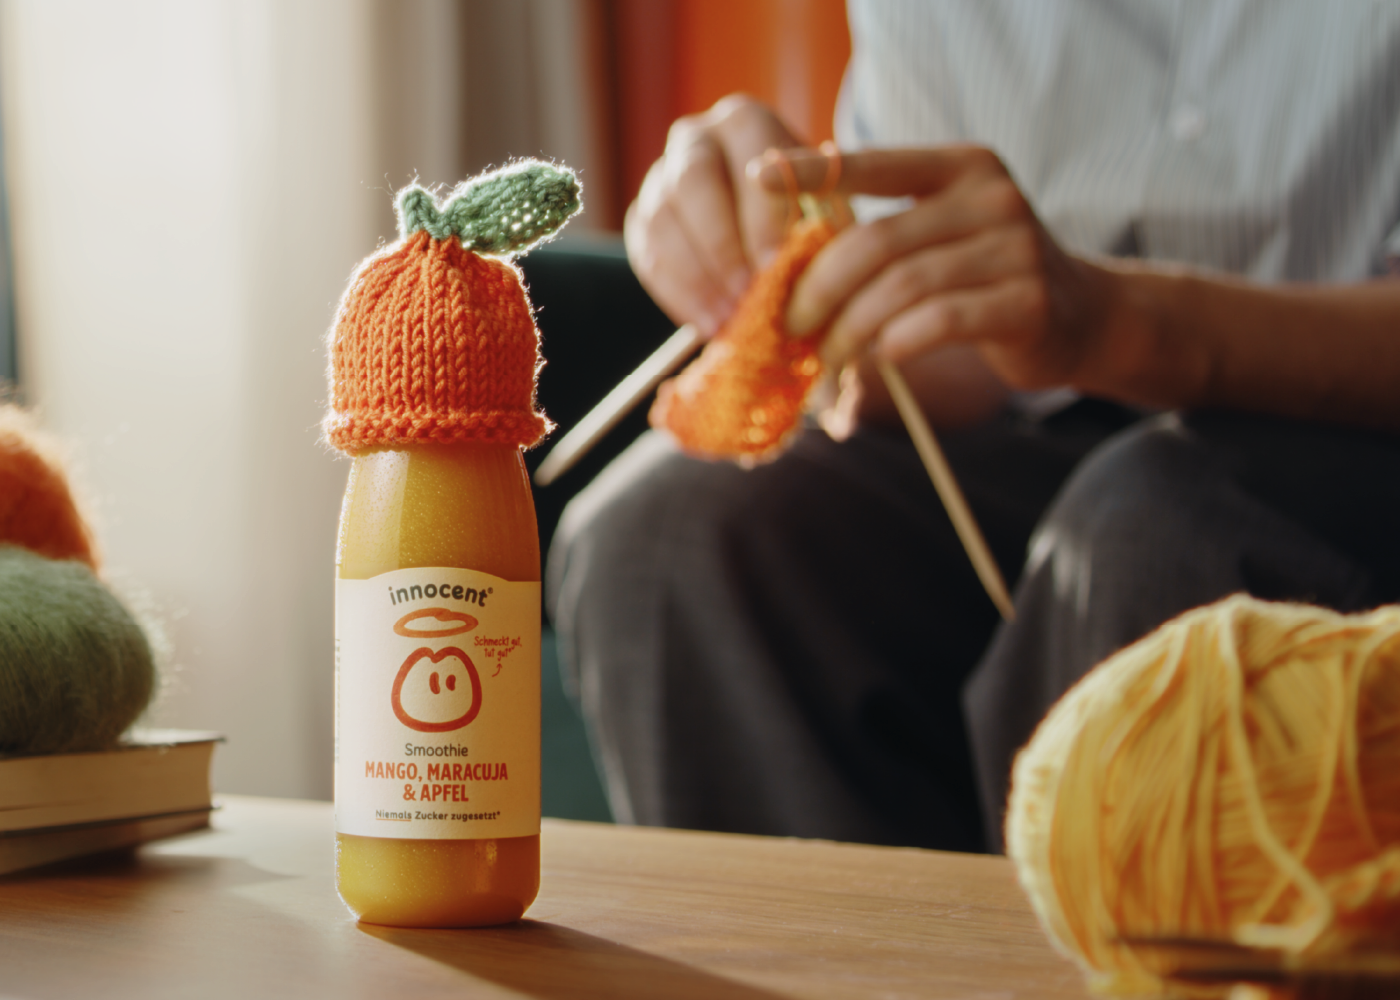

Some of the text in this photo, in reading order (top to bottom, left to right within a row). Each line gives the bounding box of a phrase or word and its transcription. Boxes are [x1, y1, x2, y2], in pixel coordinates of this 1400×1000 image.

[474, 635, 509, 647] Schmeckt
[404, 743, 469, 757] Smoothie
[365, 761, 509, 782] MANGO, MARACUJA
[403, 783, 469, 802] & APFEL
[375, 809, 412, 820] Niemals
[415, 810, 448, 820] Zucker
